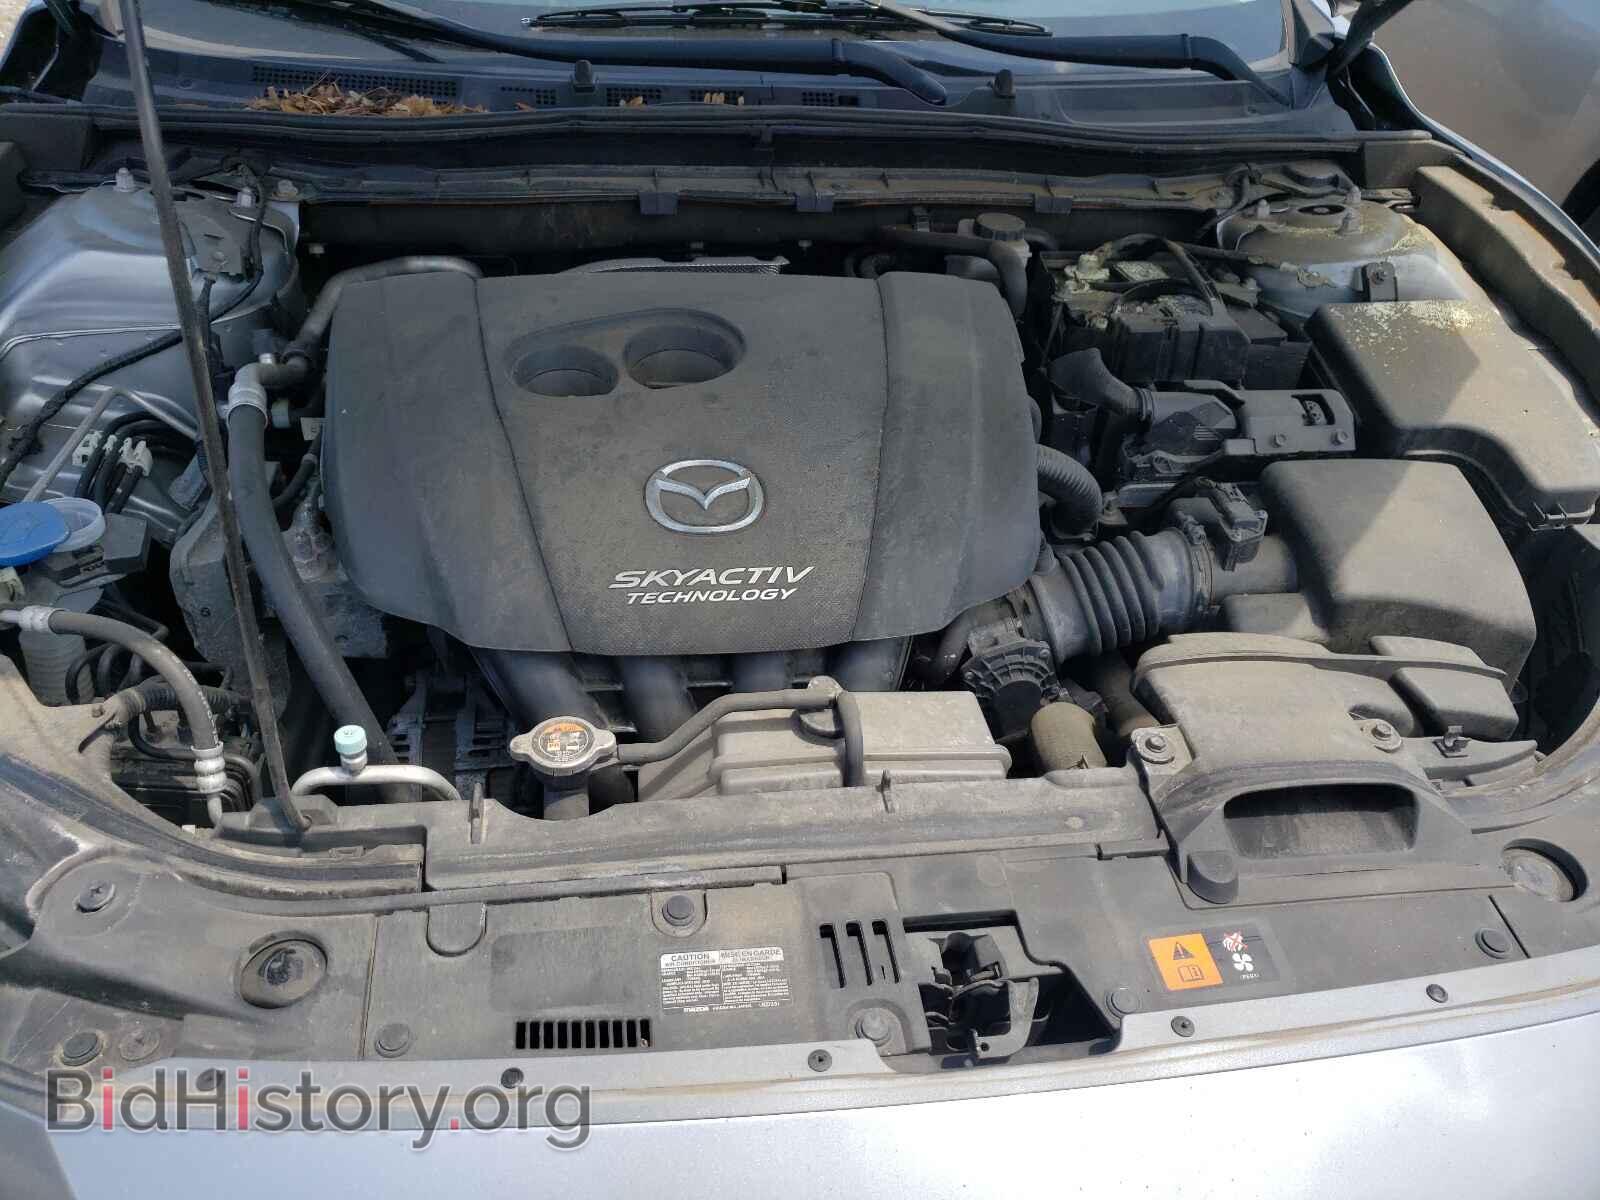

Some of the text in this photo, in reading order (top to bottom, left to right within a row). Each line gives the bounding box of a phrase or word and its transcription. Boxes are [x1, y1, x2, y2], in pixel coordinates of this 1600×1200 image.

[608, 566, 816, 589] SKYACTIV
[626, 588, 798, 605] TECHNOLOGY
[671, 953, 710, 962] CAUTION
[753, 949, 782, 957] GARDE
